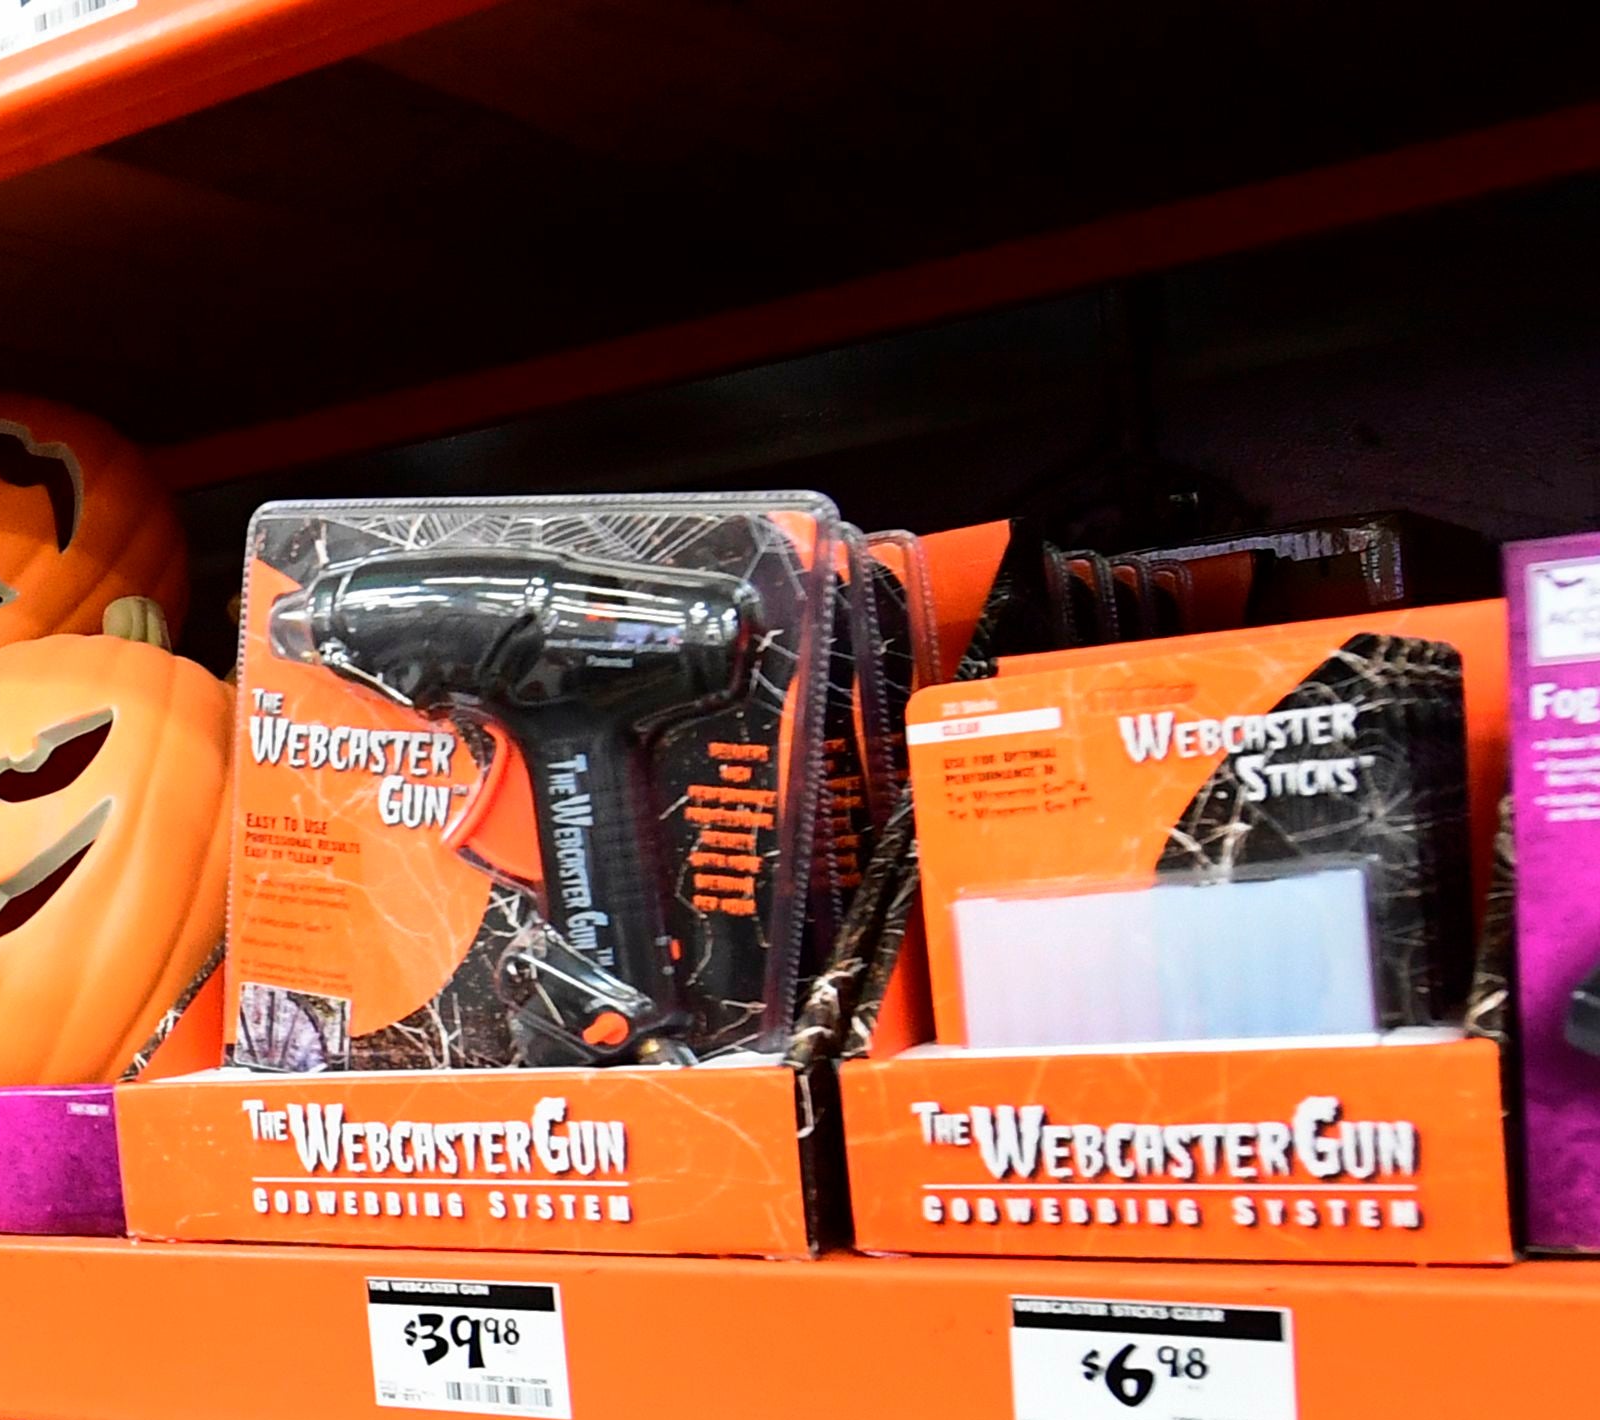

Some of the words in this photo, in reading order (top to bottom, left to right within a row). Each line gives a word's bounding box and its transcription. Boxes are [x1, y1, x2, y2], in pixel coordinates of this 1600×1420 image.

[251, 688, 284, 715] THE
[250, 716, 456, 778] WEBCASTER
[1118, 703, 1360, 764] WEBCASTER
[546, 753, 588, 796] THE
[1235, 754, 1360, 802] STICKS
[378, 775, 452, 829] GUN
[550, 794, 594, 911] WEBCASTER
[566, 910, 610, 951] GUN
[252, 1187, 465, 1219] COBWEBBING
[488, 1190, 632, 1223] SYSTEM
[922, 1195, 1201, 1227] COBWEBBING
[1232, 1195, 1422, 1230] SYSTEM
[1013, 1300, 1108, 1316] WEBCASTER
[1110, 1303, 1169, 1319] STICKS
